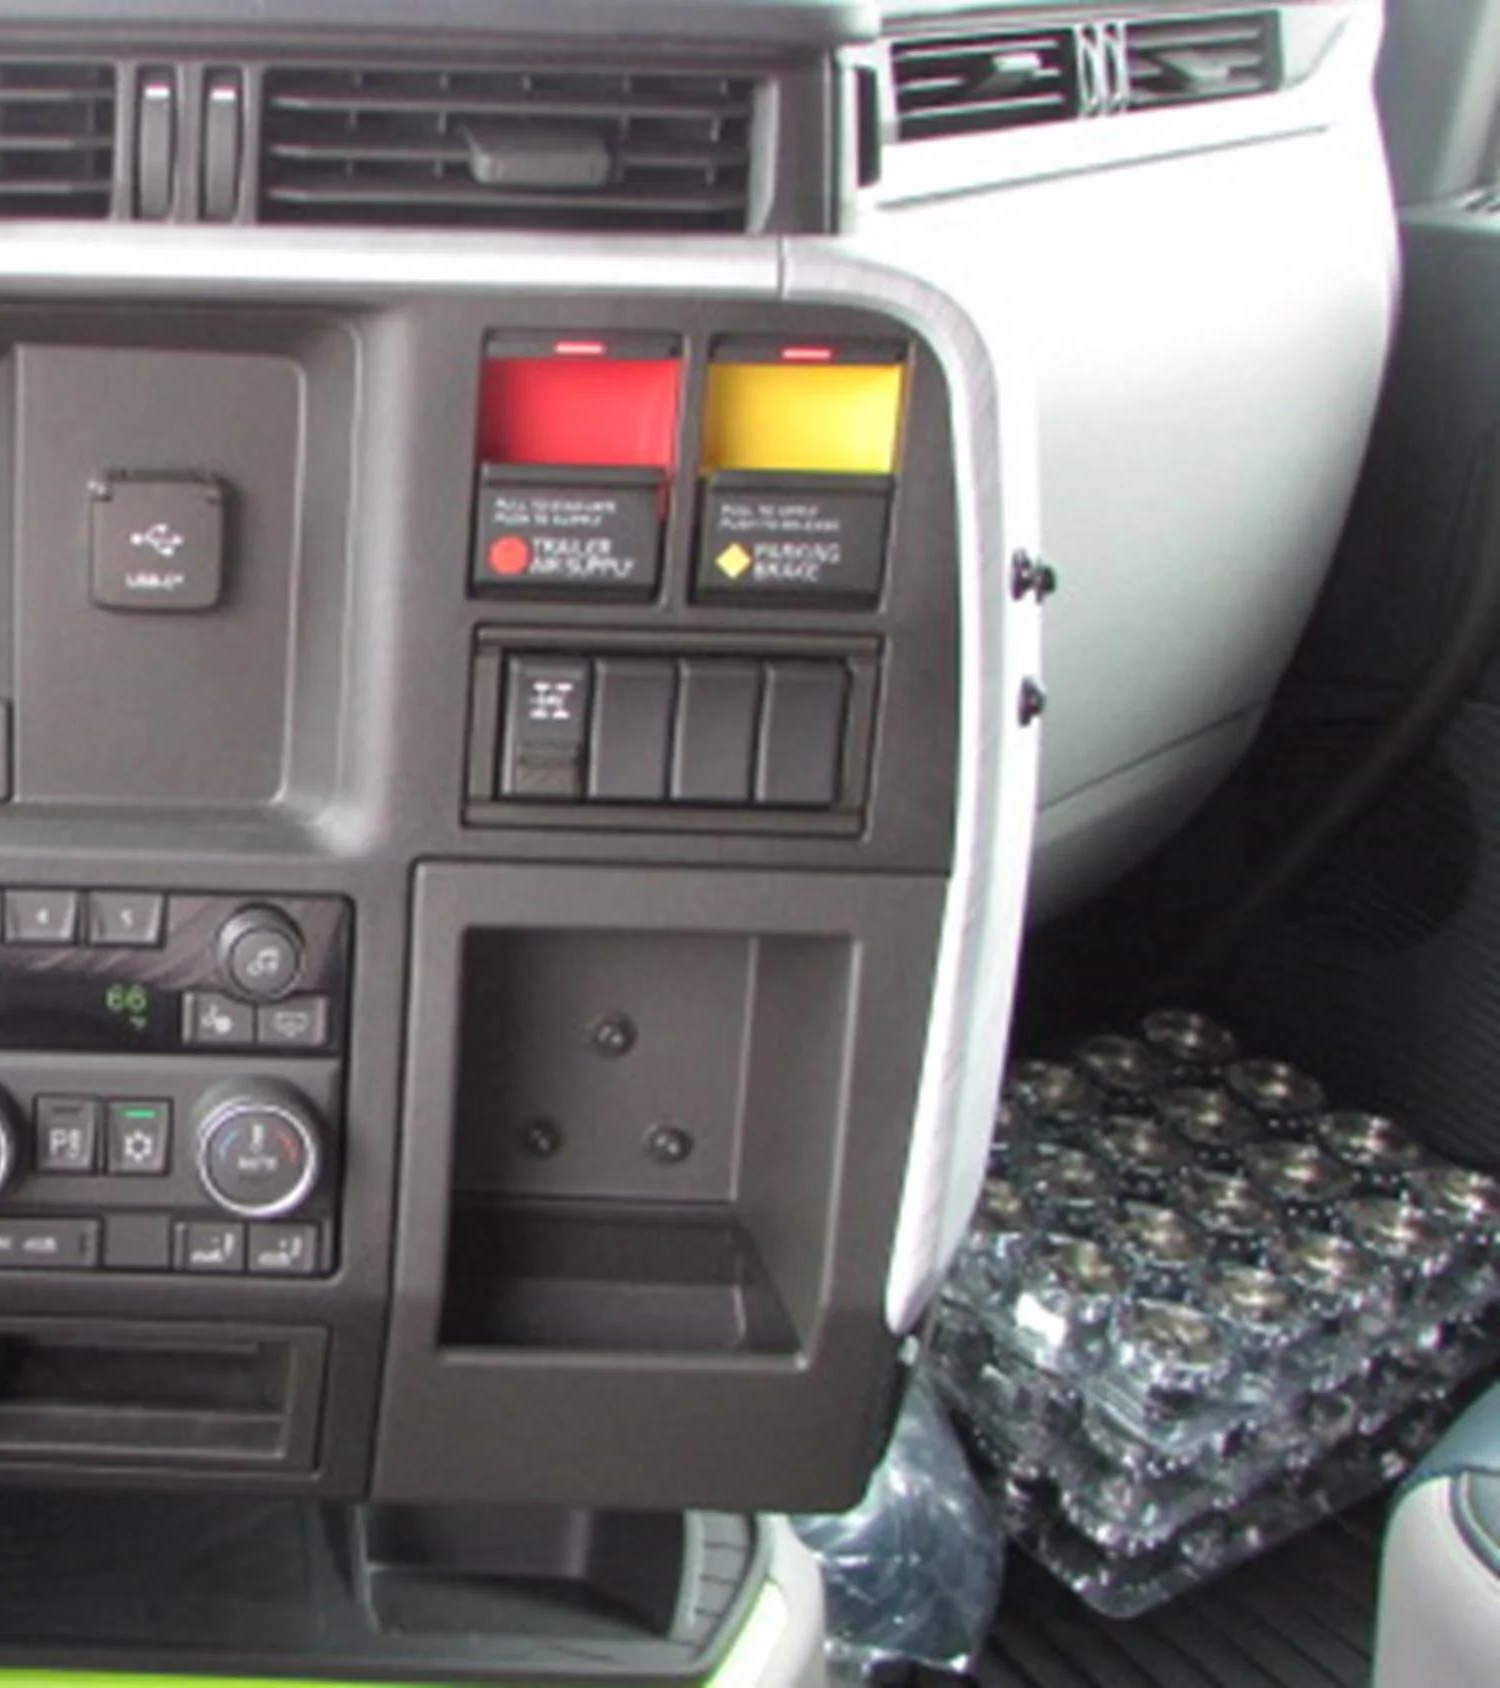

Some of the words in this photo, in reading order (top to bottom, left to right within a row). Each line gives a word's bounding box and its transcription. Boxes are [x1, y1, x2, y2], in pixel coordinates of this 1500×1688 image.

[531, 536, 613, 554] TRAILER
[753, 542, 841, 564] PARKING
[529, 556, 560, 575] AIR
[563, 555, 635, 580] SUPPLY
[753, 561, 820, 583] BRAKE
[106, 984, 148, 1012] 66
